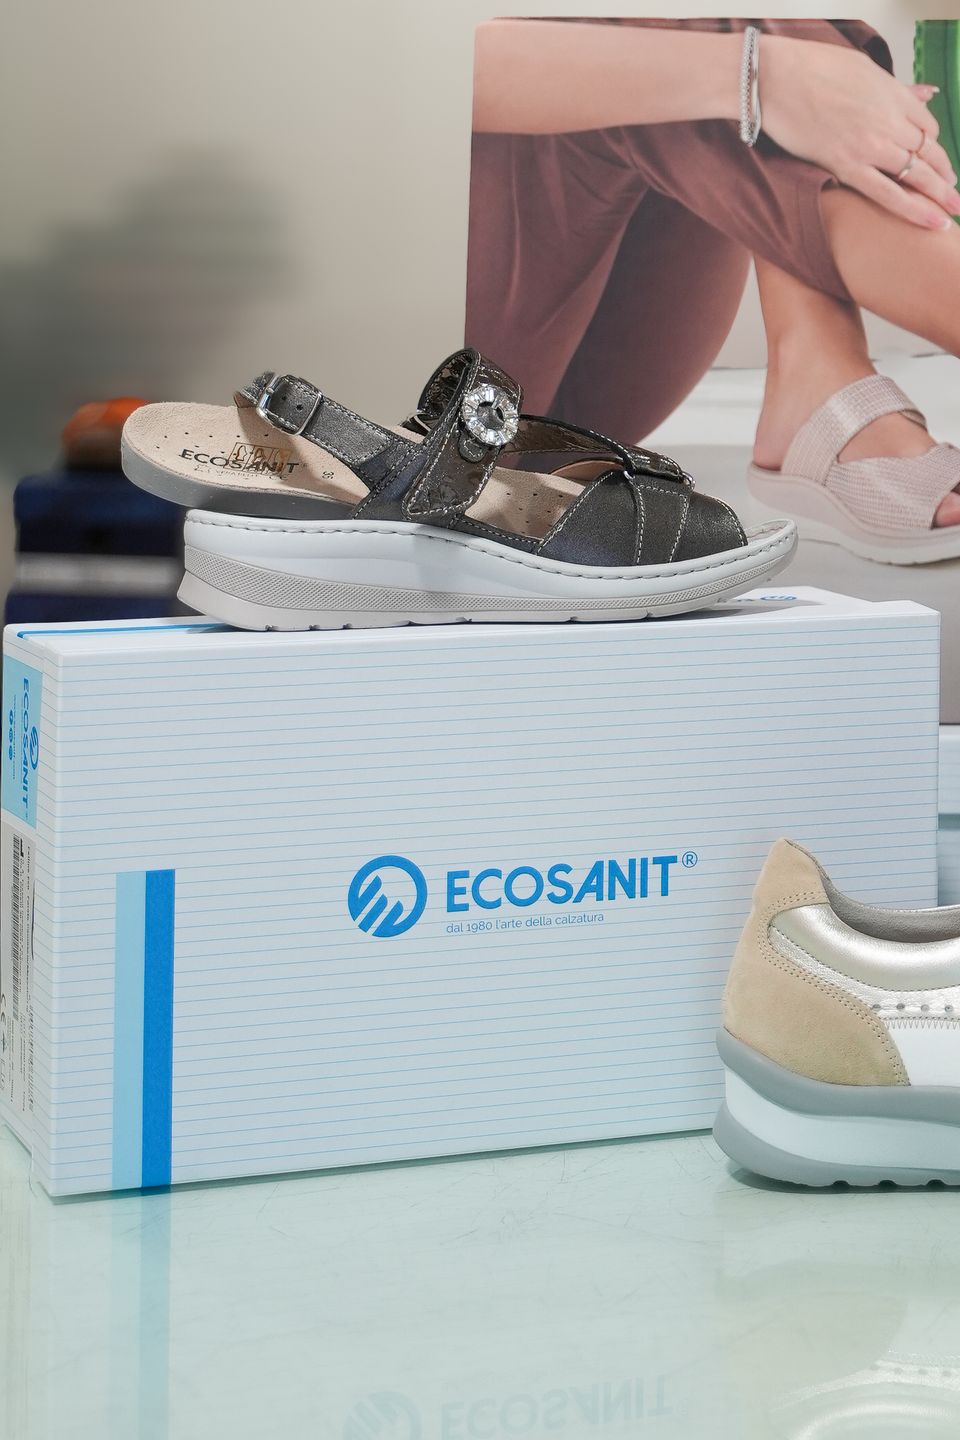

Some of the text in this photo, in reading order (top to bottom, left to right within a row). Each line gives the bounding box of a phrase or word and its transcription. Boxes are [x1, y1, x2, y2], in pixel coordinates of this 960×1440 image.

[446, 912, 605, 934] dal 1980 l'arte della calzatura
